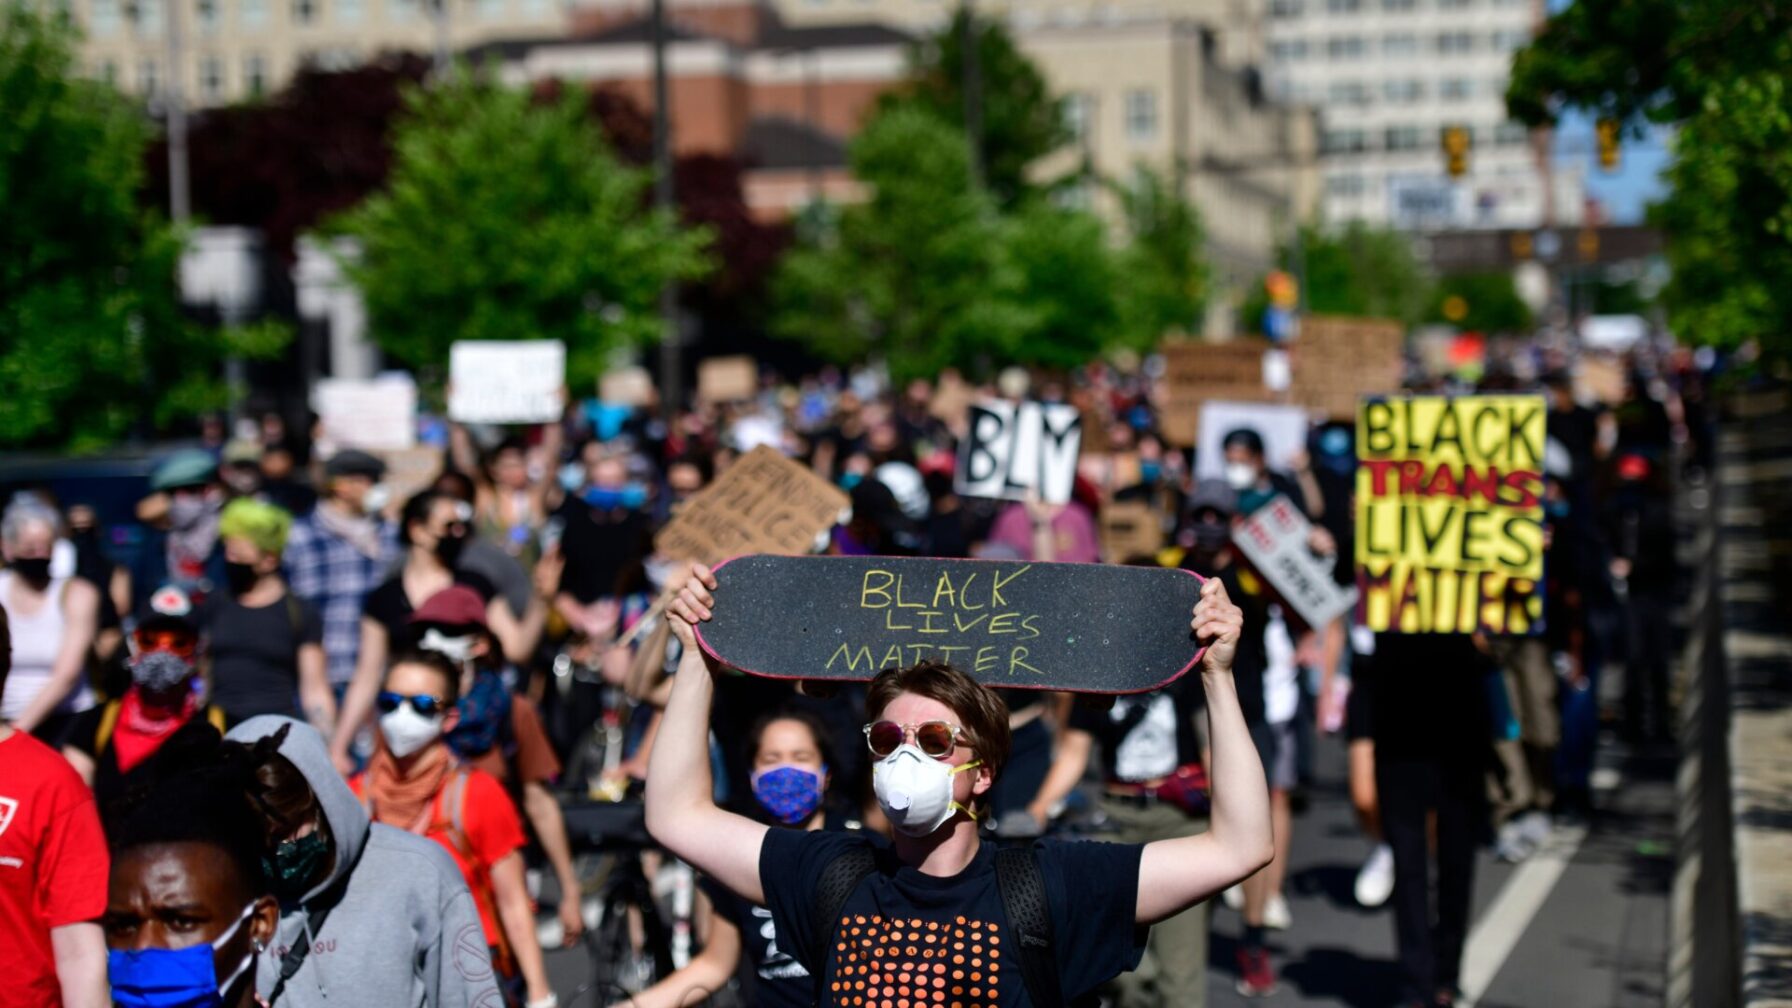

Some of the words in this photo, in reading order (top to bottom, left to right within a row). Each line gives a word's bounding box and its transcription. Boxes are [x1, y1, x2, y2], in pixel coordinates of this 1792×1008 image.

[966, 402, 1081, 500] BLM
[1366, 399, 1540, 466] BLACK
[1359, 459, 1542, 508] TRANS
[1366, 505, 1541, 568] LIVES
[861, 565, 1031, 609] BLACK
[1356, 563, 1538, 634] MATTER
[887, 609, 1040, 640] LIVES
[826, 643, 1044, 675] MATTER
